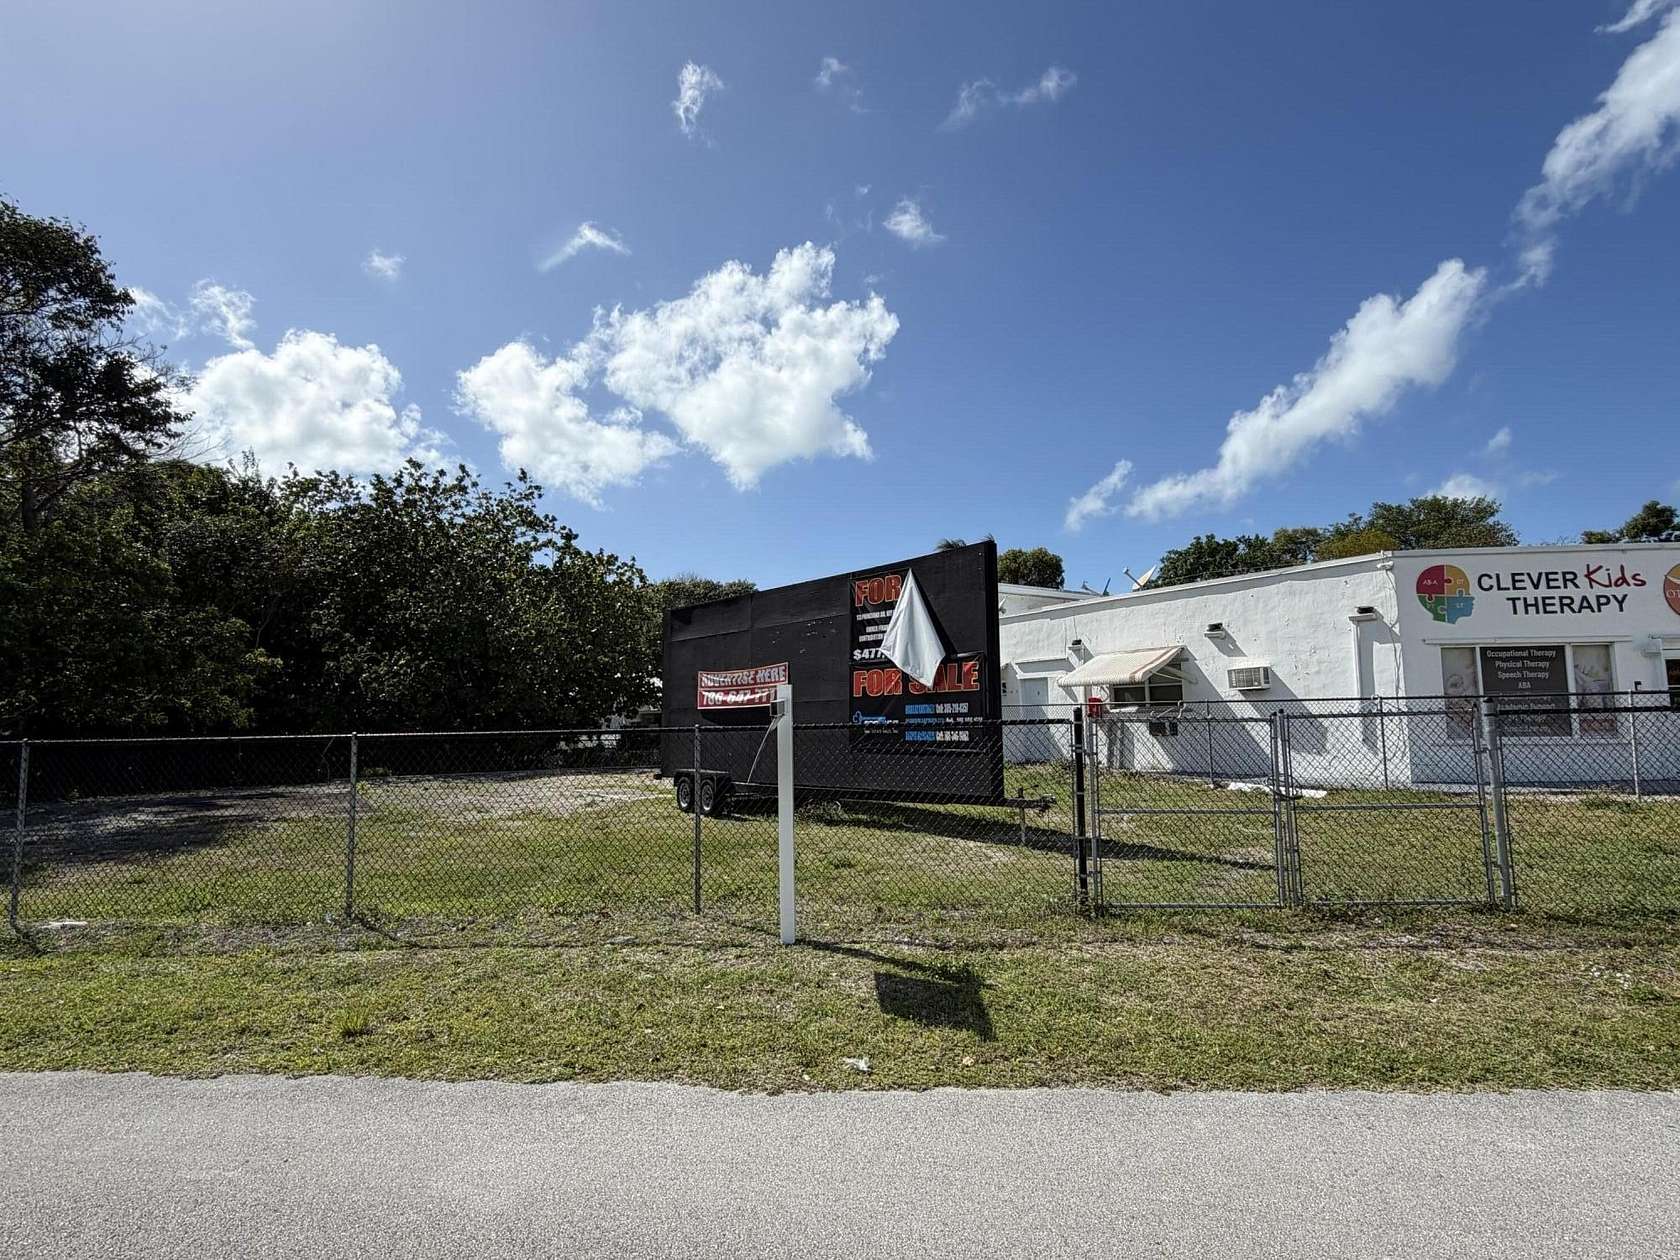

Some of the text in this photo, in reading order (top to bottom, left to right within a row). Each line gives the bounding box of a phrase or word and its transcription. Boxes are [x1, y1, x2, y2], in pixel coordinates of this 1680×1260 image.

[1477, 563, 1647, 591] CLEVER Kids
[855, 574, 902, 607] FOR
[1506, 594, 1628, 615] THERAPY
[1487, 649, 1556, 658] Occupational Therapy
[1495, 660, 1550, 669] Physical Therapy
[756, 666, 786, 682] HERE
[853, 668, 902, 697] FOR
[1497, 671, 1549, 680] Speech Therapy
